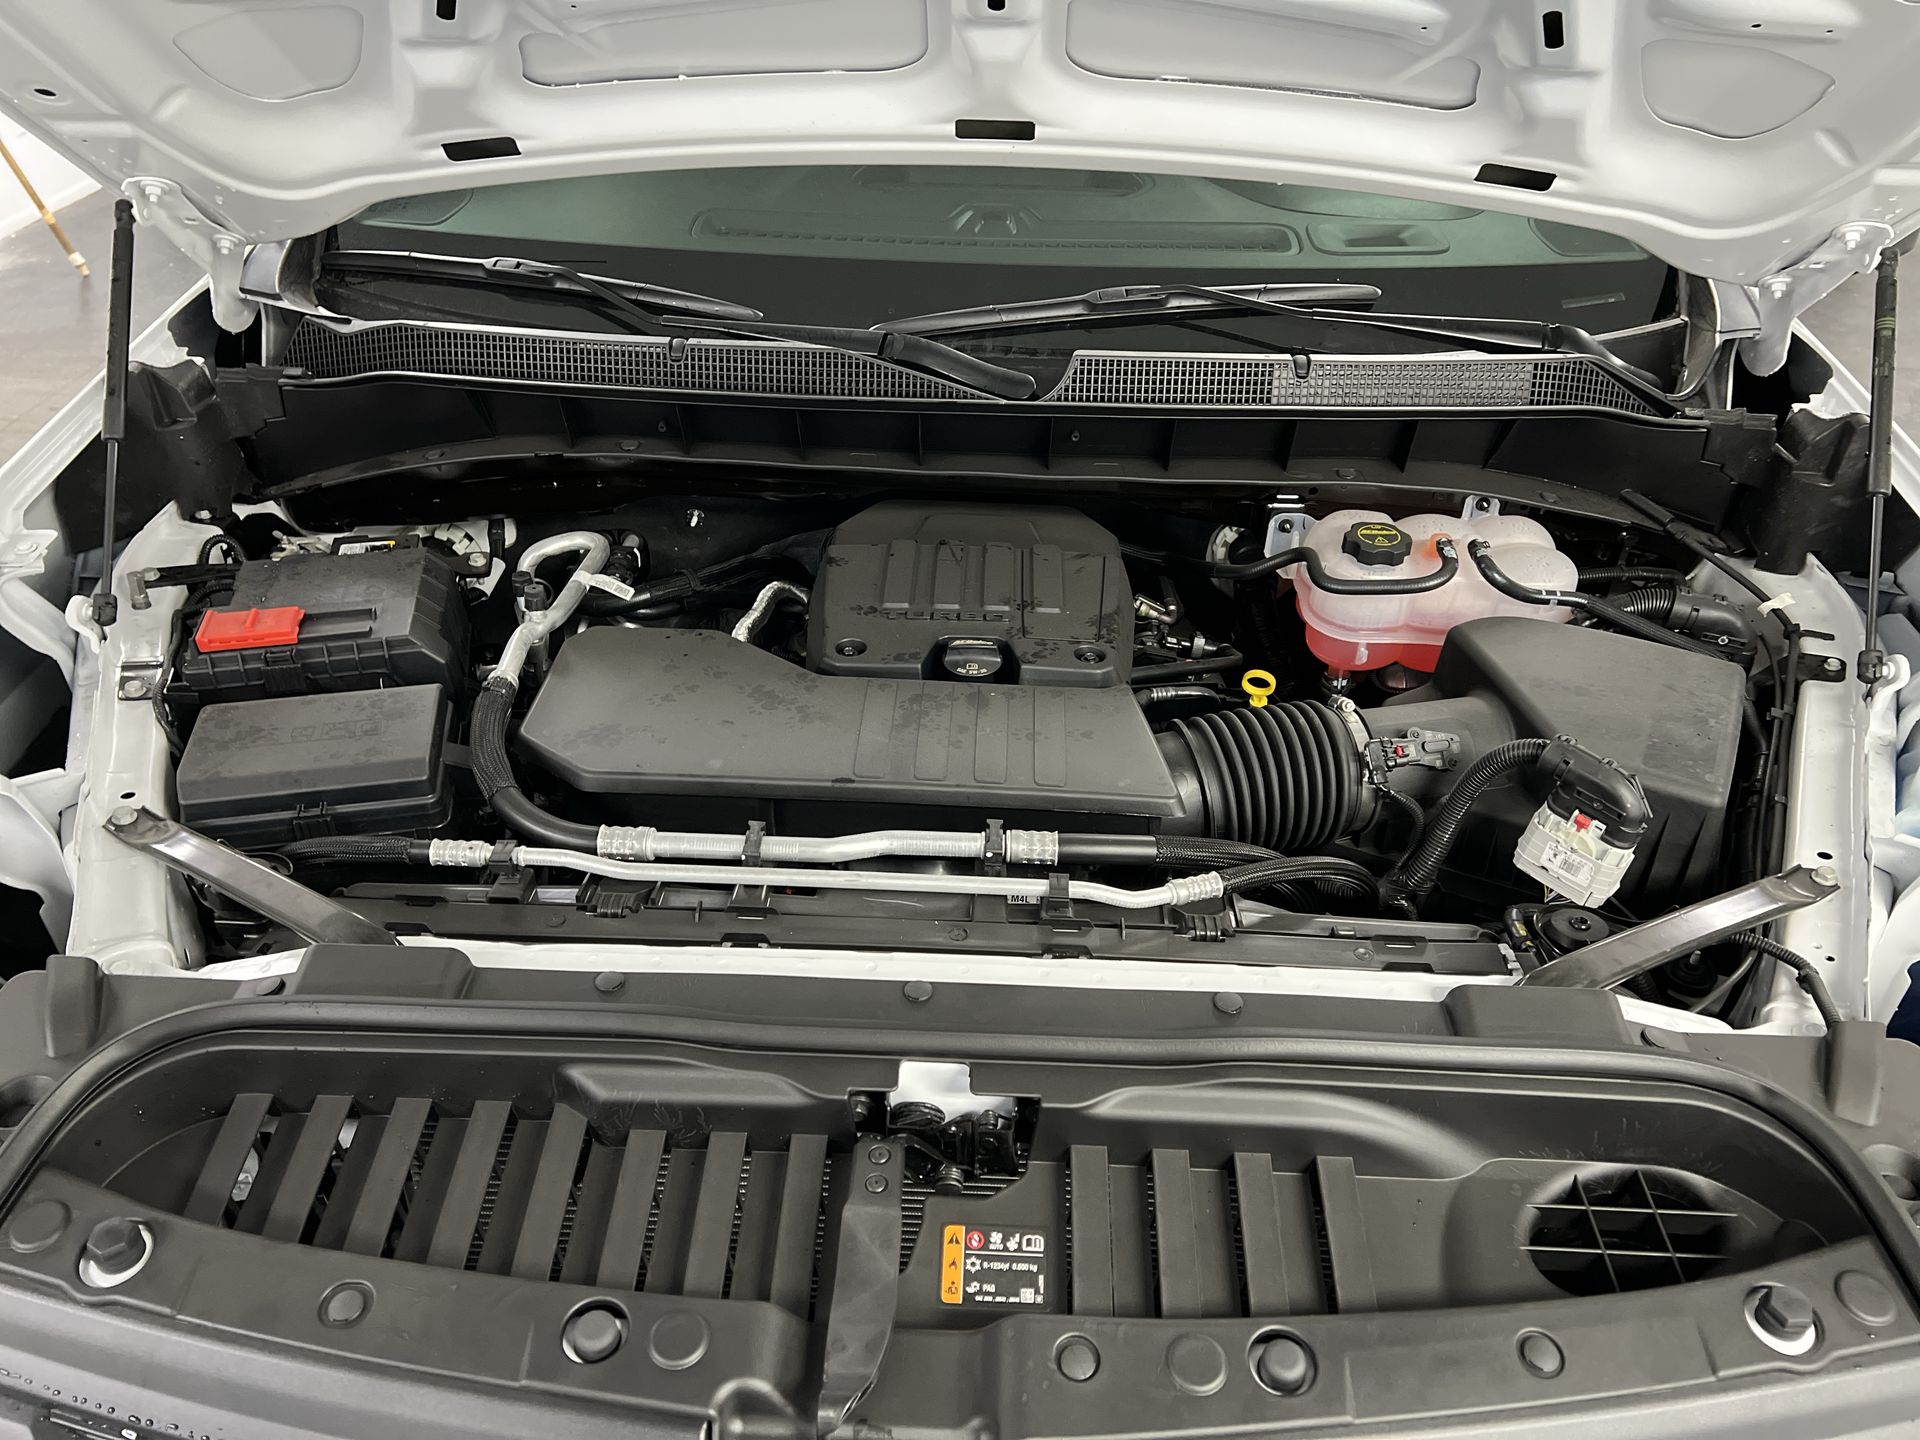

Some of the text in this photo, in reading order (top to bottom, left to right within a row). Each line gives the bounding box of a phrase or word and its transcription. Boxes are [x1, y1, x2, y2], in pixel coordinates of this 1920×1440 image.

[881, 610, 1009, 623] TURBO
[983, 1261, 1010, 1272] R-1234yf
[1030, 1263, 1038, 1273] kg
